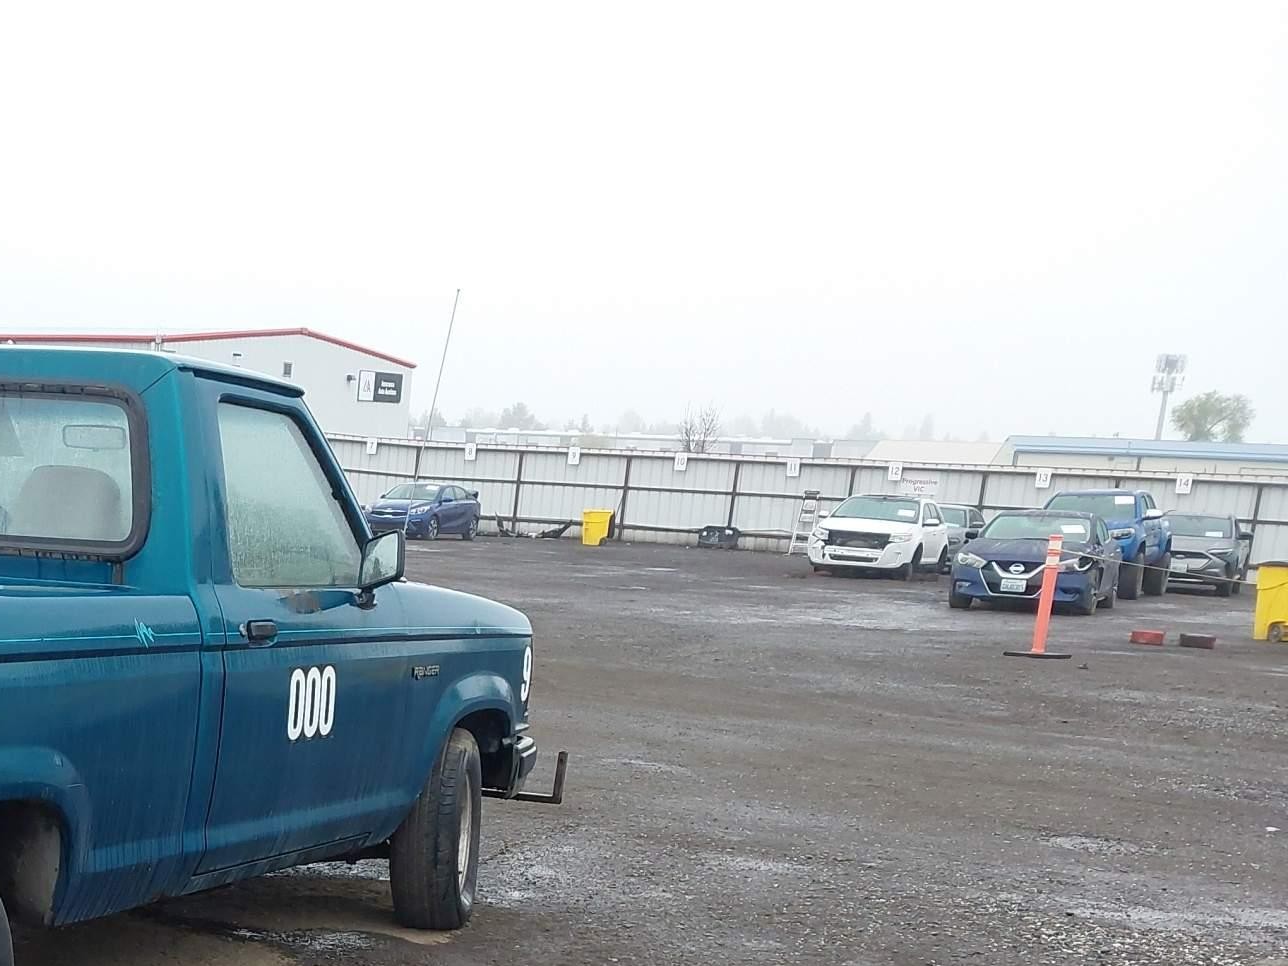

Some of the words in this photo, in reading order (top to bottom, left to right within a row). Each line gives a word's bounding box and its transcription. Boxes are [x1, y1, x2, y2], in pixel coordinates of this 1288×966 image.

[676, 456, 685, 466] 10
[890, 466, 900, 476] 12
[902, 477, 938, 486] Progressive
[1038, 473, 1048, 482] 13
[1179, 478, 1190, 488] 14
[414, 664, 441, 680] RANGER
[287, 665, 336, 741] 000
